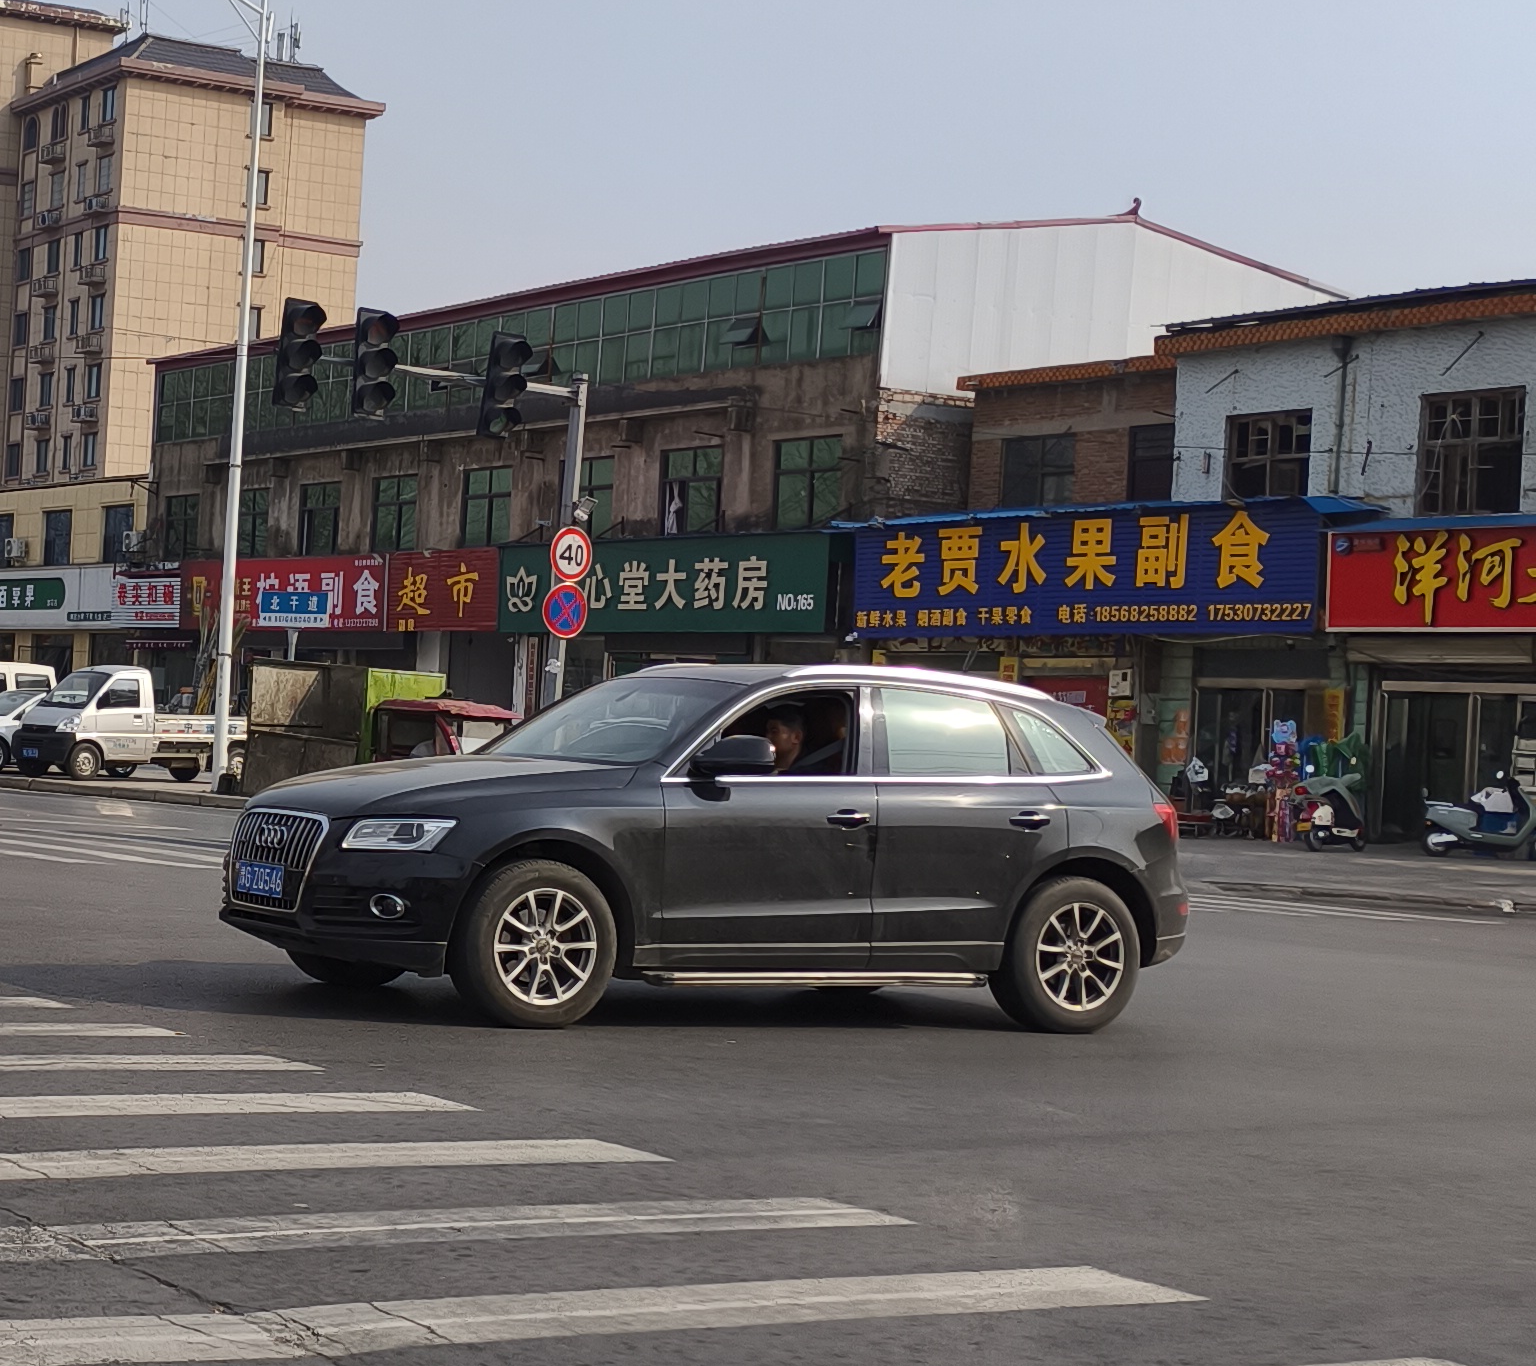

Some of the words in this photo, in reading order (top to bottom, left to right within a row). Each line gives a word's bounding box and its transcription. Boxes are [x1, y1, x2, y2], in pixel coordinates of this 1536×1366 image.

[559, 543, 584, 567] 40
[880, 511, 1271, 599] 老贾水果副食
[396, 562, 480, 618] 超市
[269, 595, 319, 612] 北干道
[856, 610, 908, 629] 新鲜水果
[917, 608, 969, 627] 烟酒副食
[978, 606, 1033, 625] 干果零食
[1208, 603, 1312, 622] 17530732227
